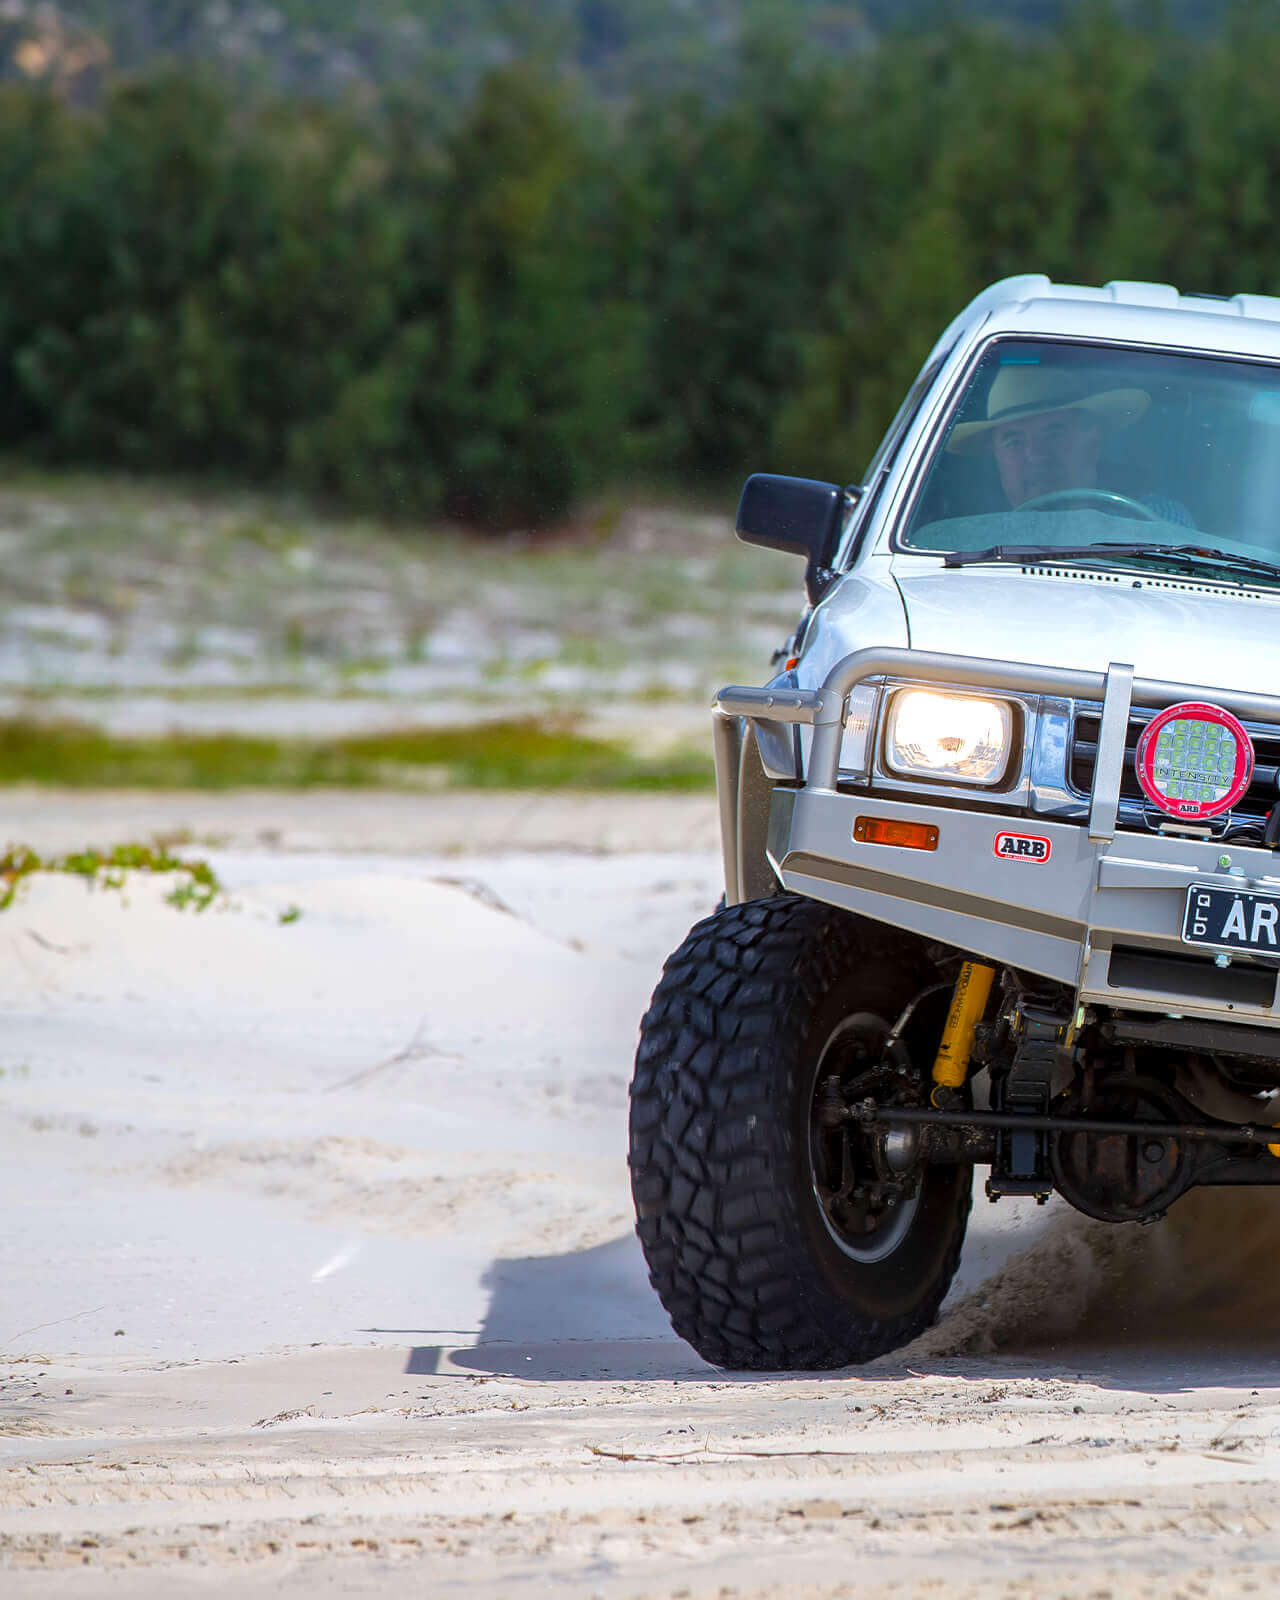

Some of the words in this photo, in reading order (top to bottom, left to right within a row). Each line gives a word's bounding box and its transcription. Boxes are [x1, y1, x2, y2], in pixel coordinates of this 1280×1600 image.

[1179, 804, 1199, 813] ARB
[1000, 837, 1046, 858] ARB
[1192, 893, 1211, 937] QLD
